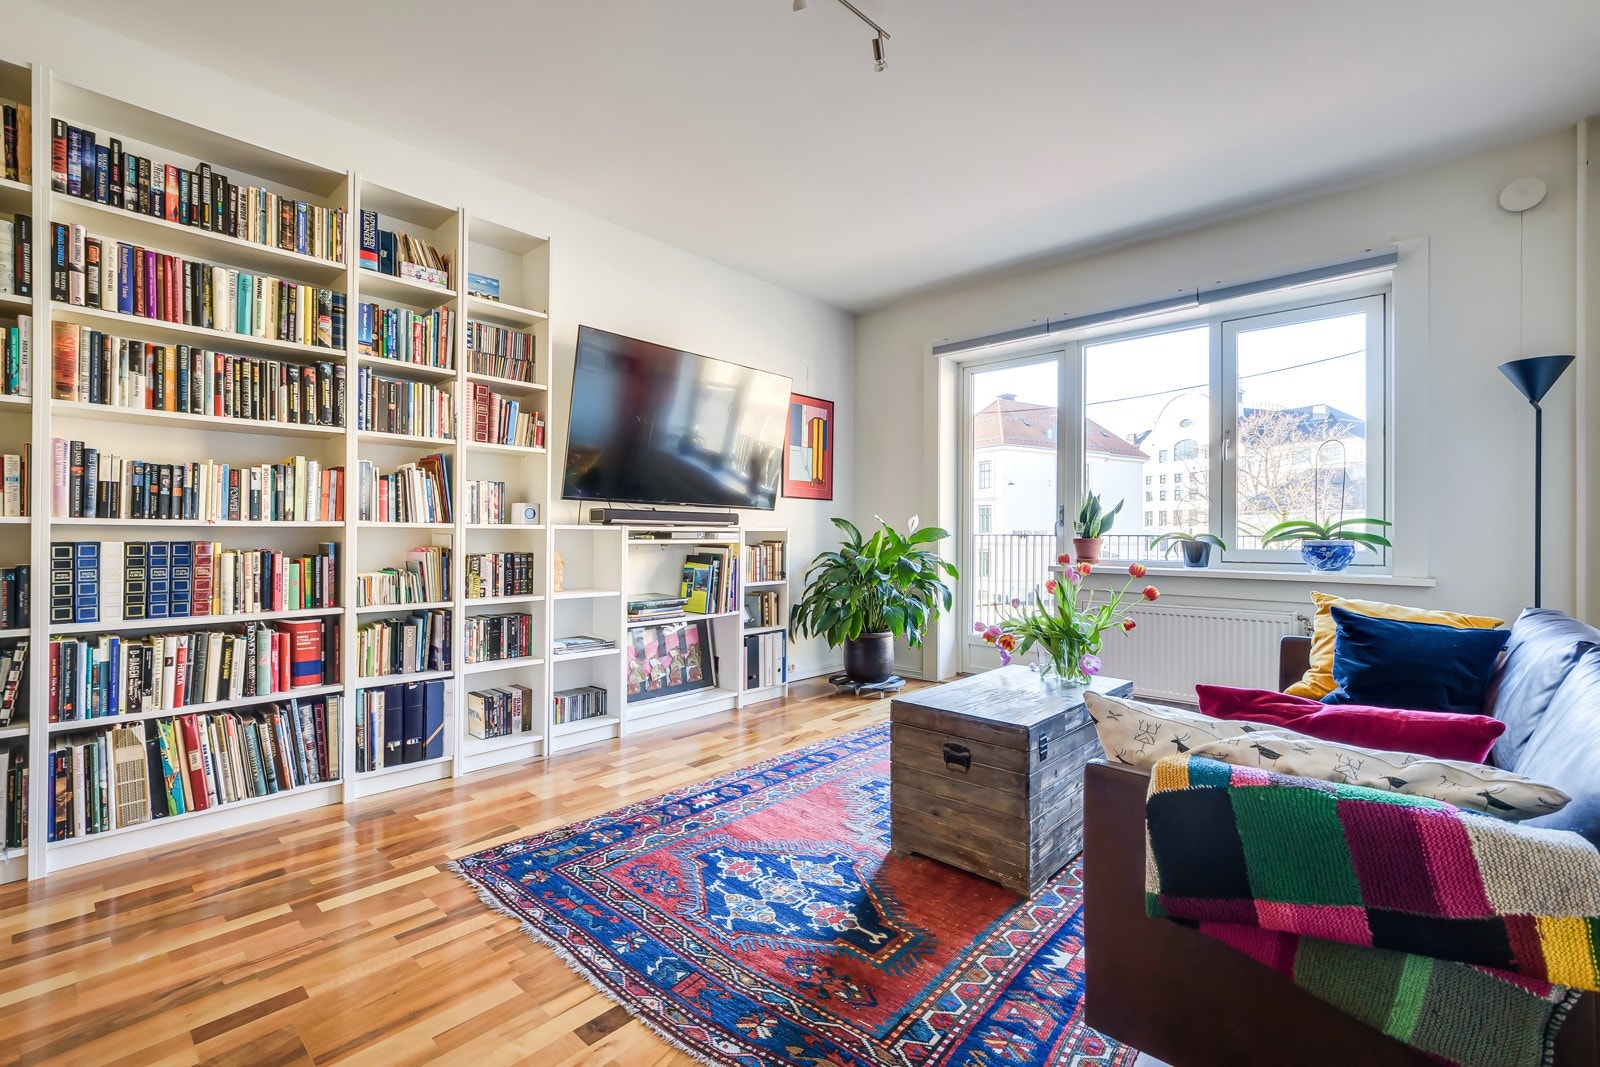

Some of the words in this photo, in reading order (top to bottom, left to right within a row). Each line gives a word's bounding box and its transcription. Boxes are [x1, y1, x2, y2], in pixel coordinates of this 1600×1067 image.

[52, 137, 68, 174] TOKYO
[247, 626, 256, 655] KOSMOS
[129, 649, 140, 679] D-DAGEN
[176, 663, 185, 686] HEKTA
